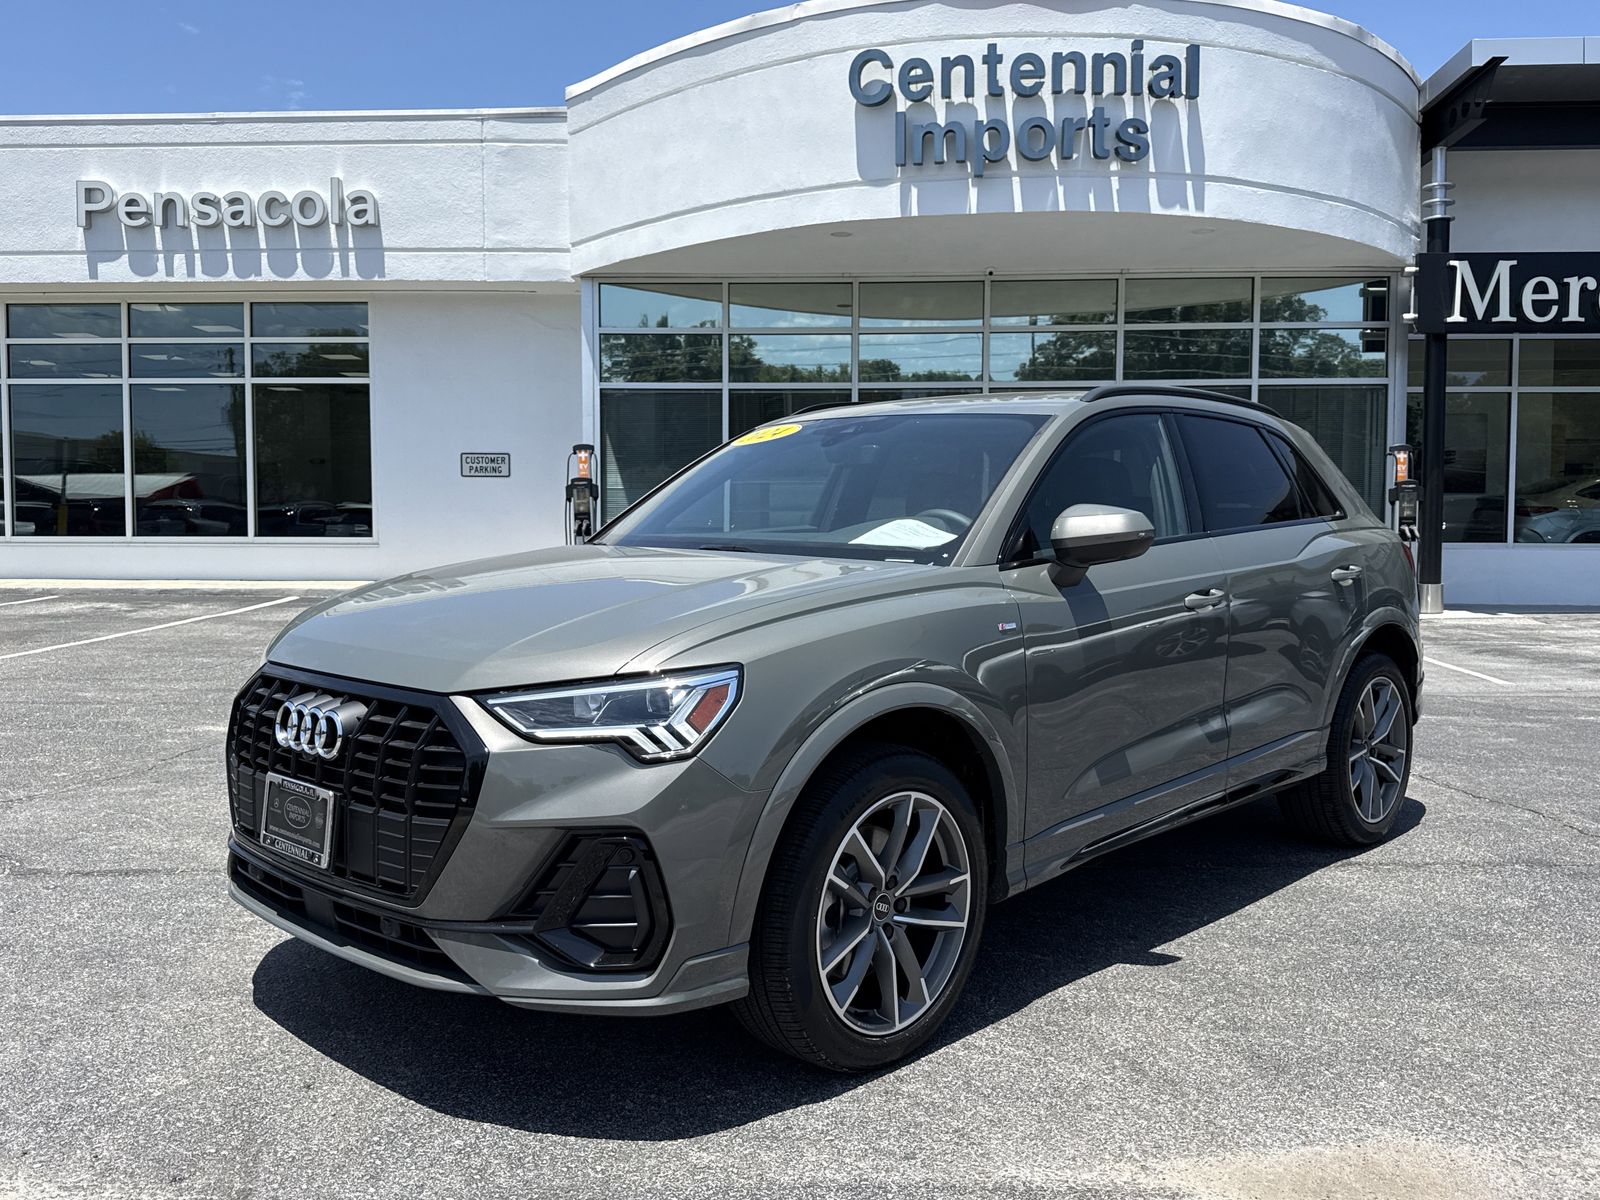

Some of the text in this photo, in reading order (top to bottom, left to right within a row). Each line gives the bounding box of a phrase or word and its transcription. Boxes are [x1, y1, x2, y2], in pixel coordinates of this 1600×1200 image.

[849, 39, 1200, 107] Centennial
[895, 107, 1150, 177] Imports
[76, 177, 380, 229] Pensacola
[1446, 260, 1600, 323] Mer
[465, 456, 506, 464] CUSTOMER
[469, 465, 502, 474] PARKING
[274, 840, 309, 860] CENTENNIAL
